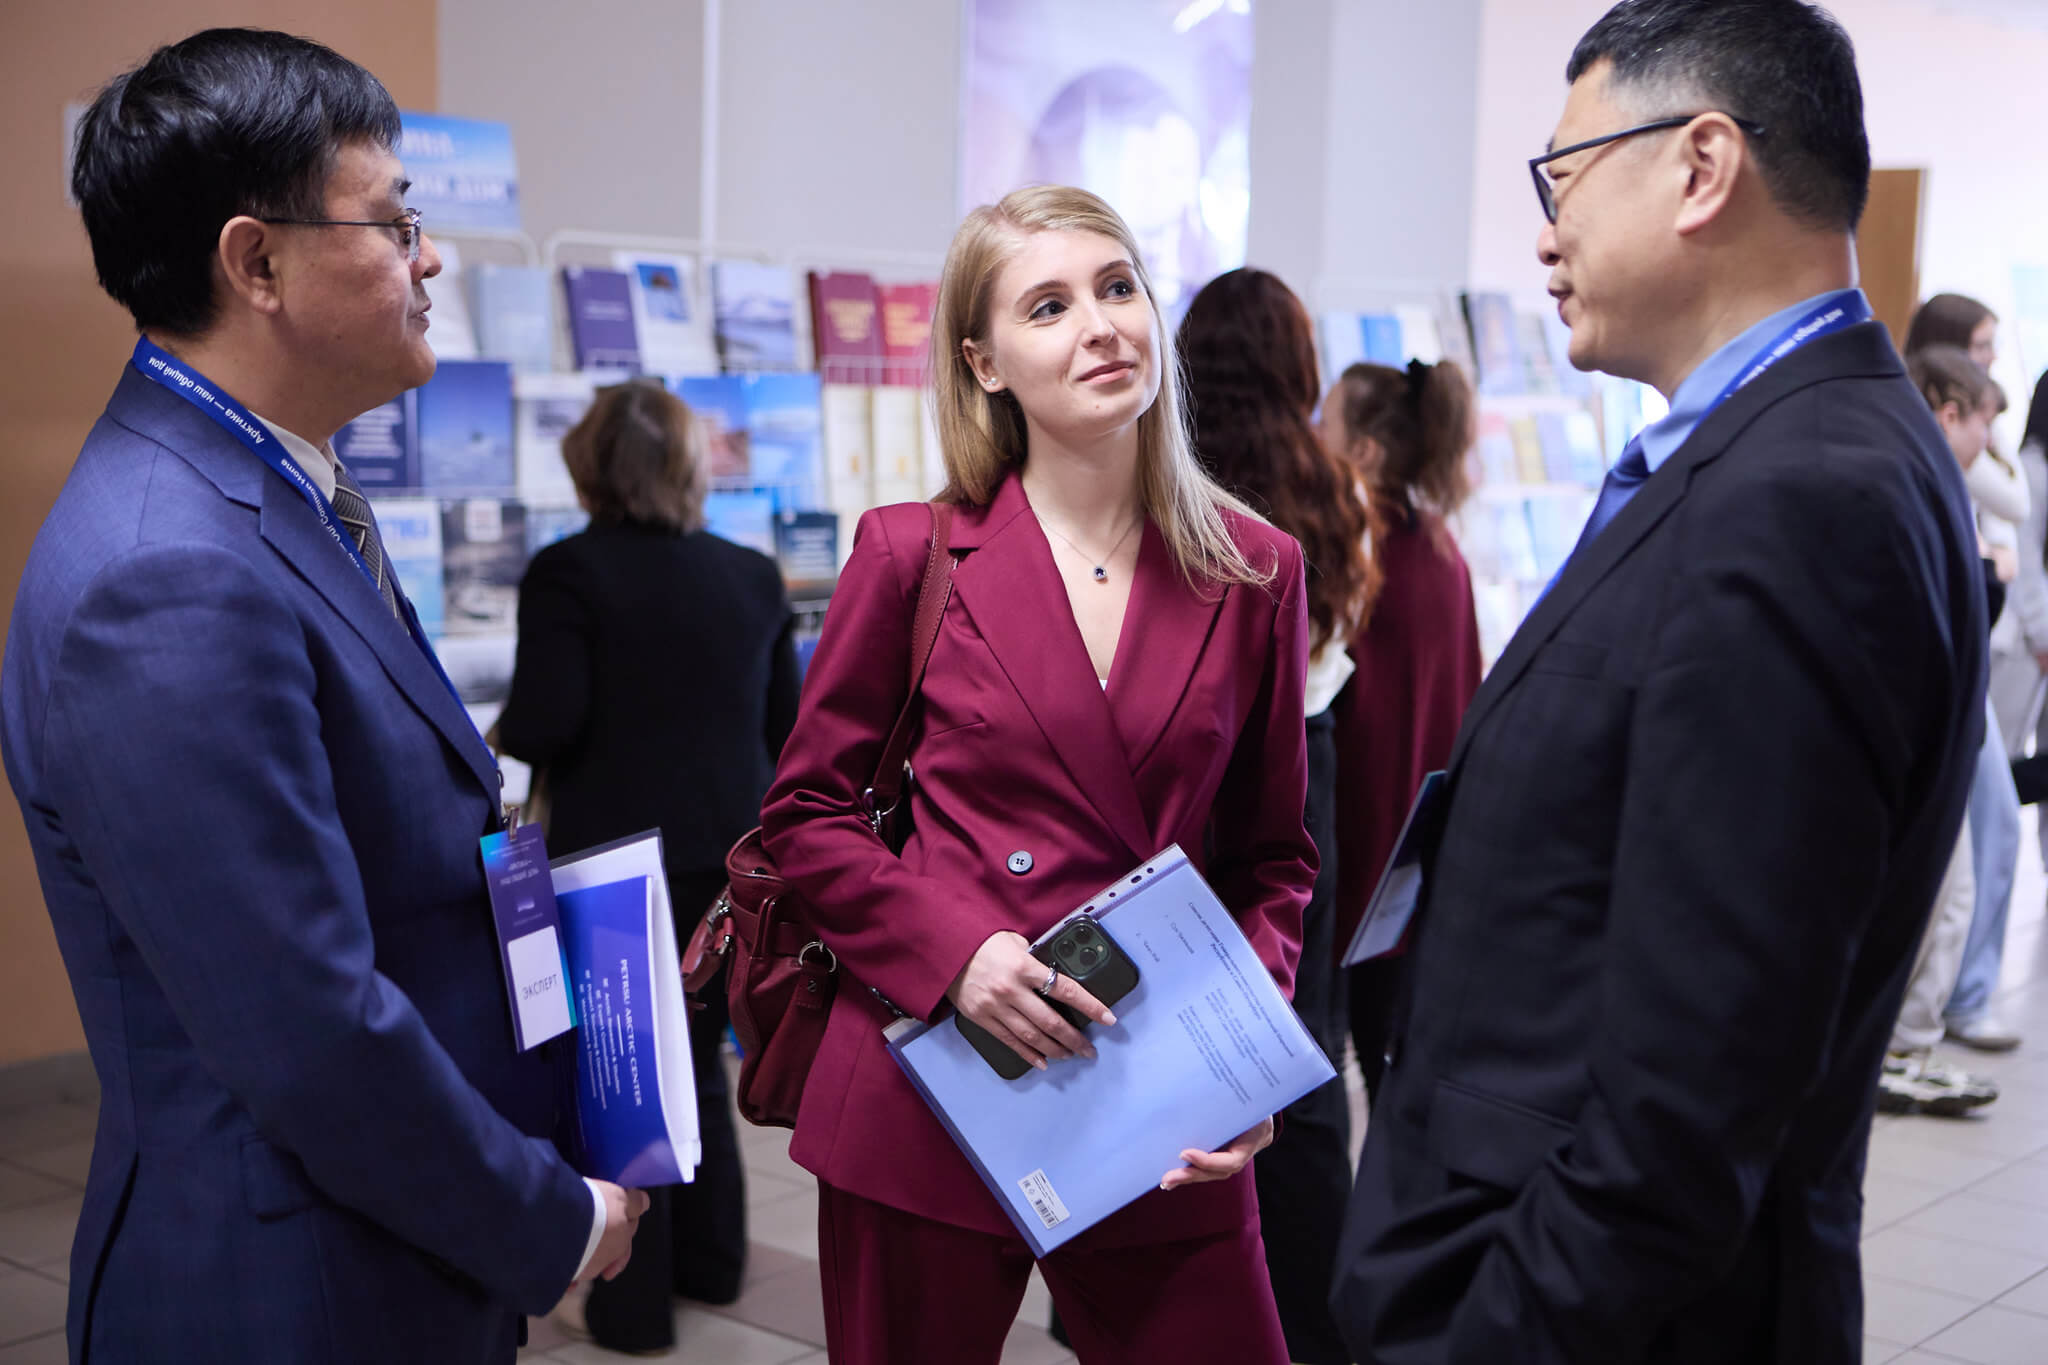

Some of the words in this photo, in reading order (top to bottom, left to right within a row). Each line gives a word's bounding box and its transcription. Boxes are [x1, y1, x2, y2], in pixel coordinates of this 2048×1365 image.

[148, 356, 167, 371] дом
[163, 366, 195, 388] общий
[193, 385, 215, 403] наш
[224, 408, 265, 444] Арктика
[281, 458, 306, 485] Home
[305, 482, 329, 525] Common
[522, 973, 557, 1001] ЭКСПЕРТ
[625, 1007, 636, 1055] ARCTIC
[630, 1057, 642, 1107] CENTER
